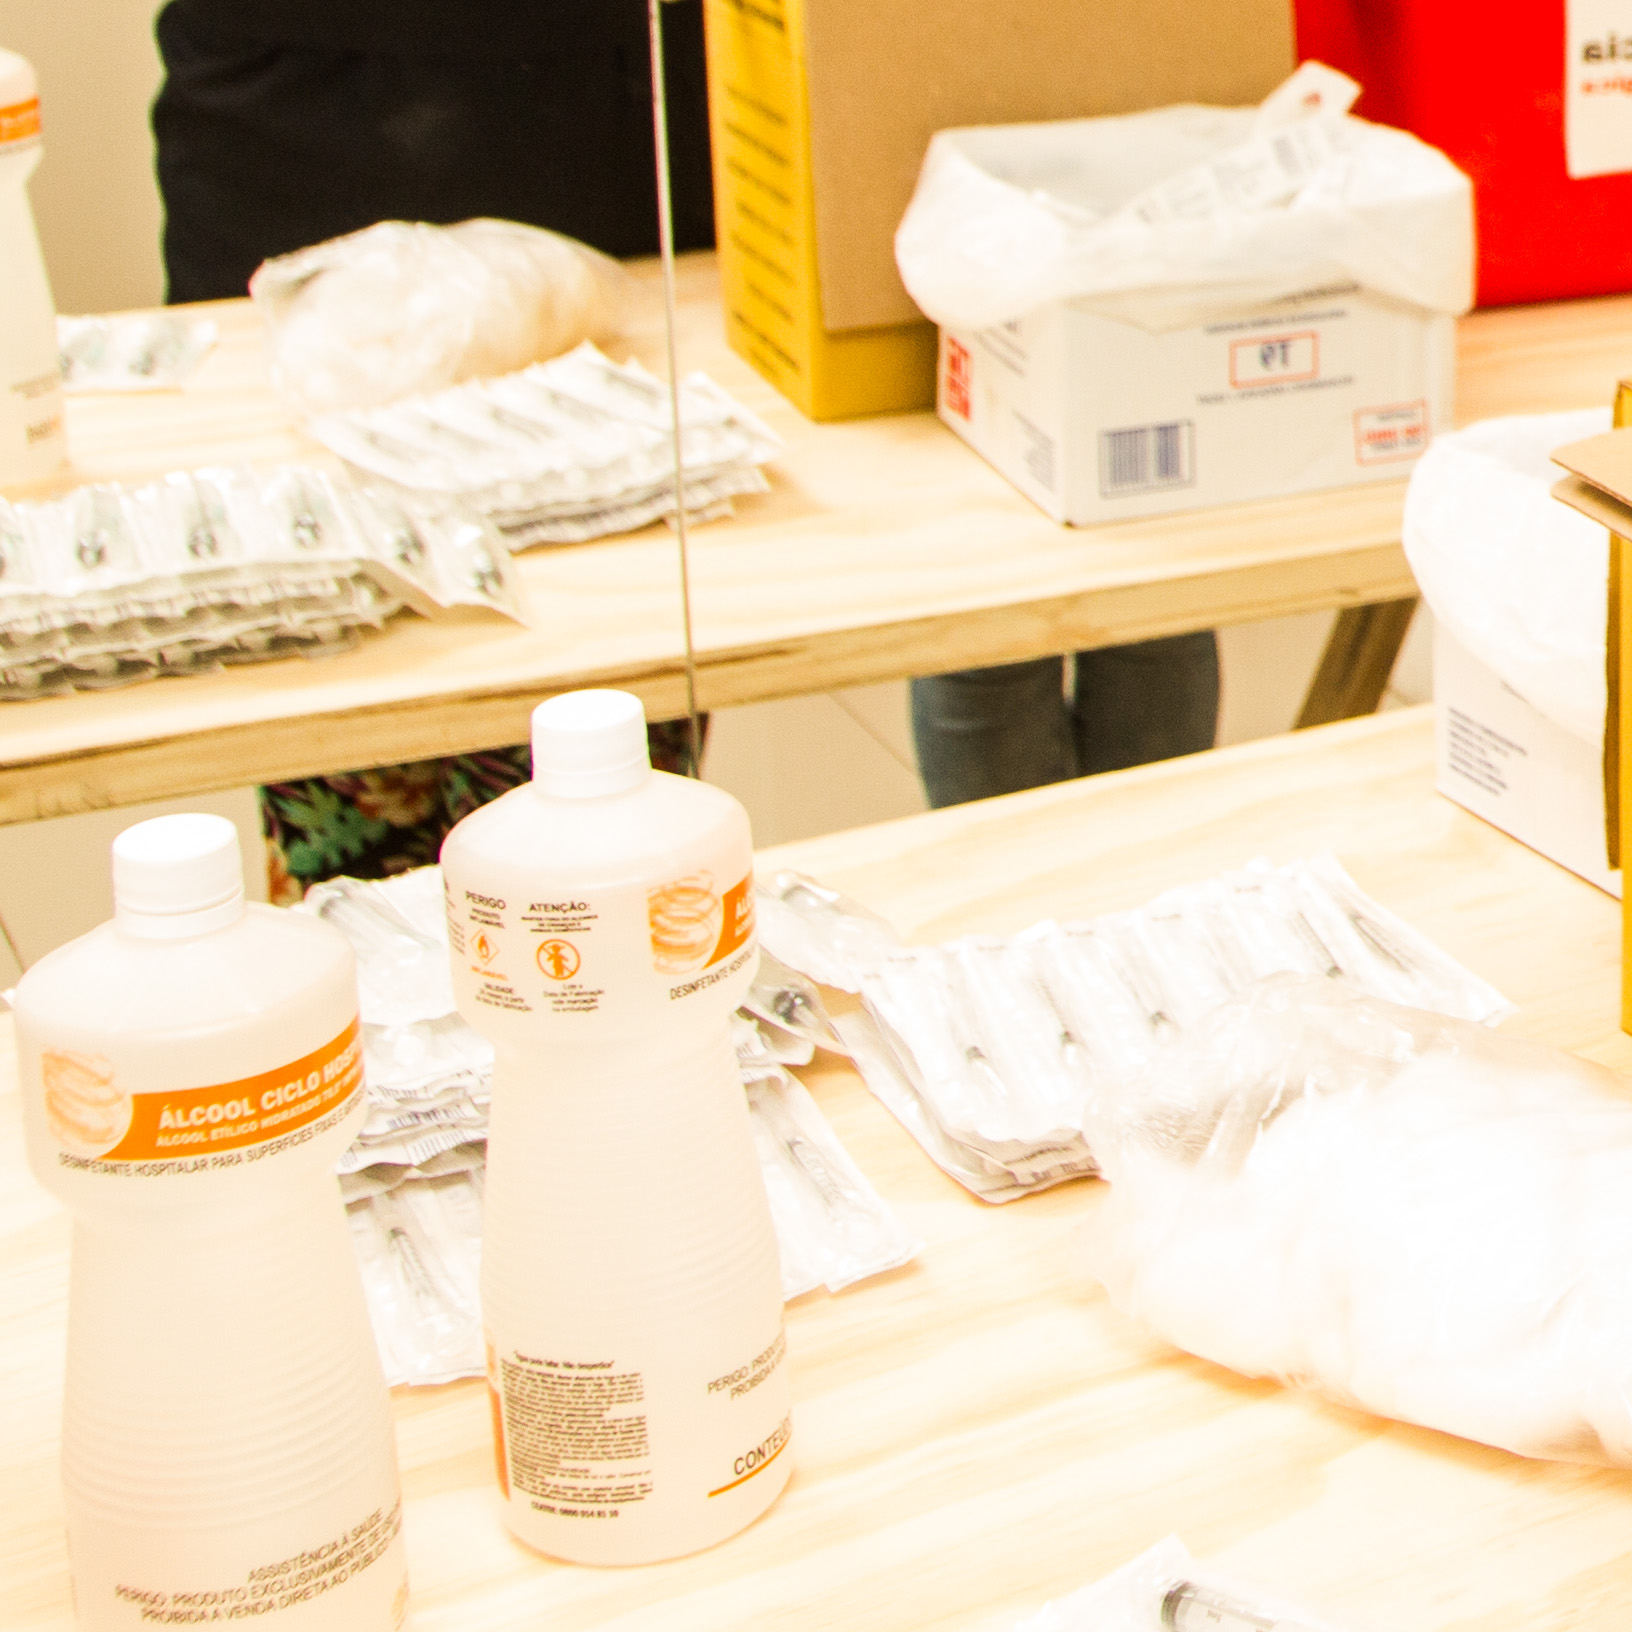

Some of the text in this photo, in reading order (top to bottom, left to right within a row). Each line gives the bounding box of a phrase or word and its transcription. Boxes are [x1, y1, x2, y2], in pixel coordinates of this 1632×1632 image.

[465, 890, 507, 911] PERIGO
[159, 1097, 256, 1131] ÁLCOOL
[260, 1068, 322, 1111] CICLO
[156, 1128, 208, 1148] ÁLCOOL
[210, 1120, 259, 1143] ETÍLICO
[58, 1151, 134, 1178] DESINFETANTE
[134, 1156, 209, 1178] HOSPITALAR
[211, 1152, 243, 1170] PARA
[171, 1586, 247, 1607] PRODUTO
[250, 1536, 367, 1599] EXCLUSIVAMENTE
[248, 1539, 338, 1583] ASSISTÊNCIA
[140, 1606, 210, 1625] PROIBIDA
[224, 1594, 276, 1622] VENDA
[278, 1578, 328, 1611] DIRETA
[329, 1568, 350, 1589] AO
